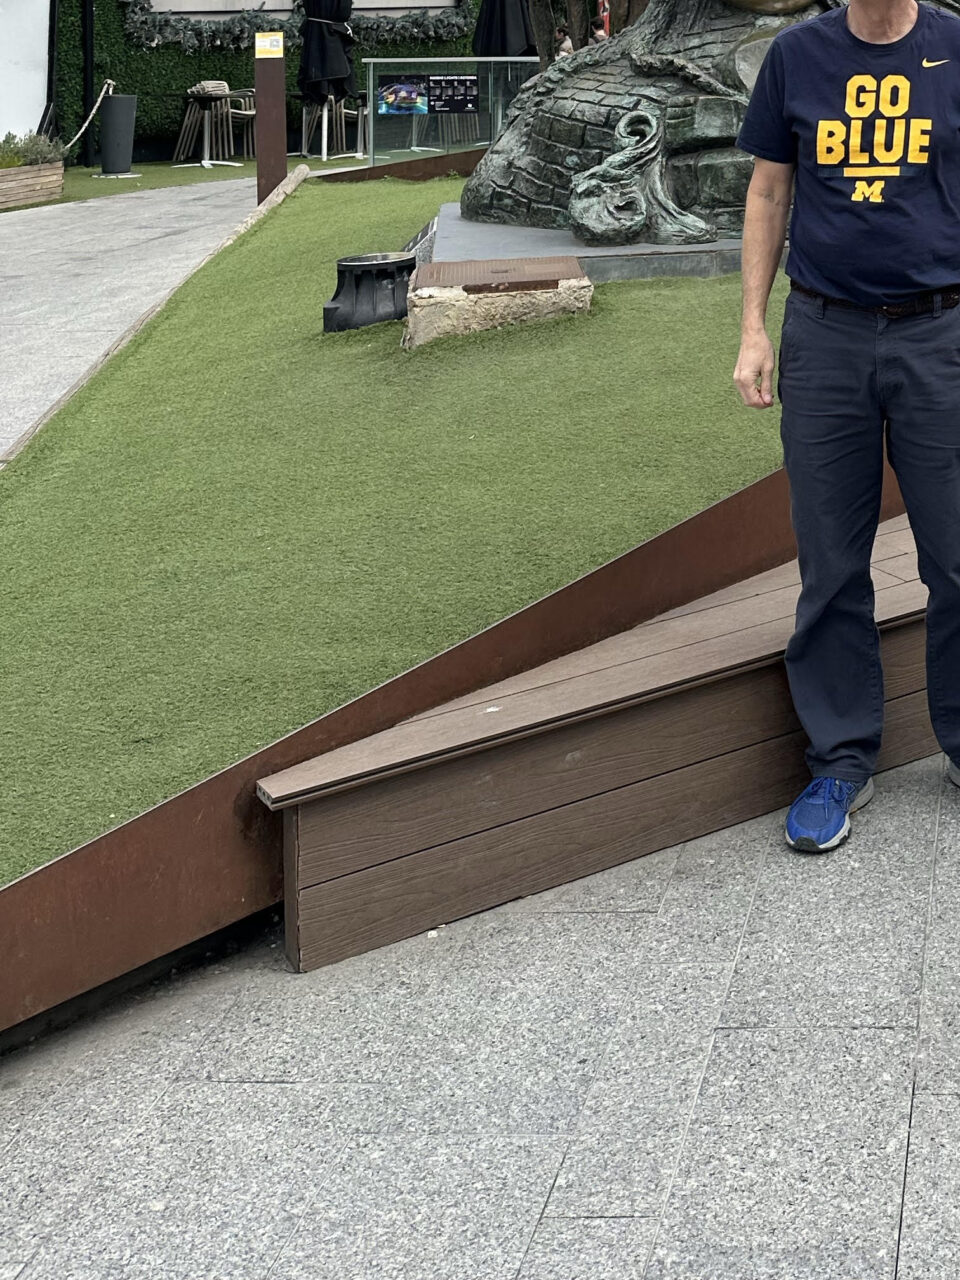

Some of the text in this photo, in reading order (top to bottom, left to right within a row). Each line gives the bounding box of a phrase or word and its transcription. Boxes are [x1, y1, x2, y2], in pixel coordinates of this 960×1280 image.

[845, 74, 911, 118] GO
[816, 118, 932, 165] BLUE
[851, 180, 885, 203] M
